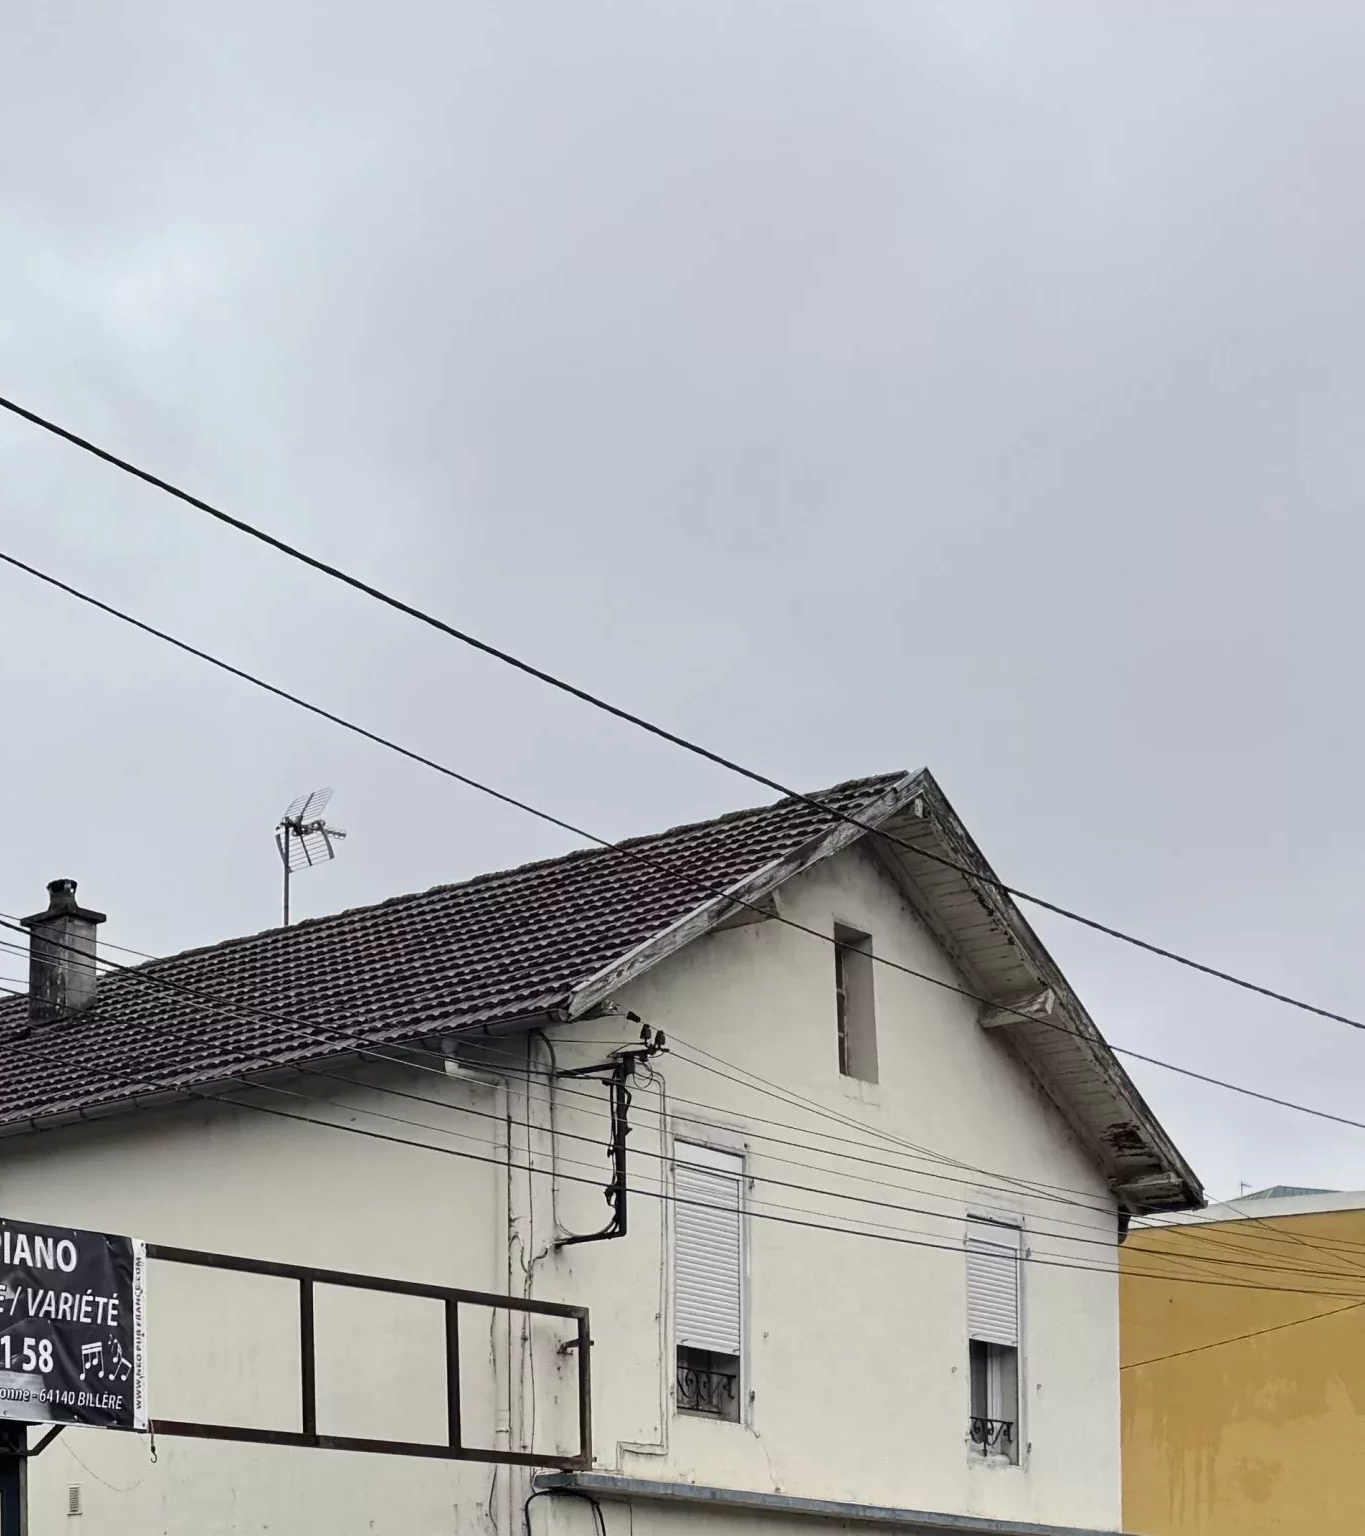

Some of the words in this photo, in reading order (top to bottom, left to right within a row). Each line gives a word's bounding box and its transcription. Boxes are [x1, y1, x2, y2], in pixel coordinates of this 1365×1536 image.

[10, 1286, 22, 1316] /
[26, 1287, 120, 1327] VARIÉTÉ
[22, 1335, 54, 1373] 58
[38, 1387, 76, 1406] 64140
